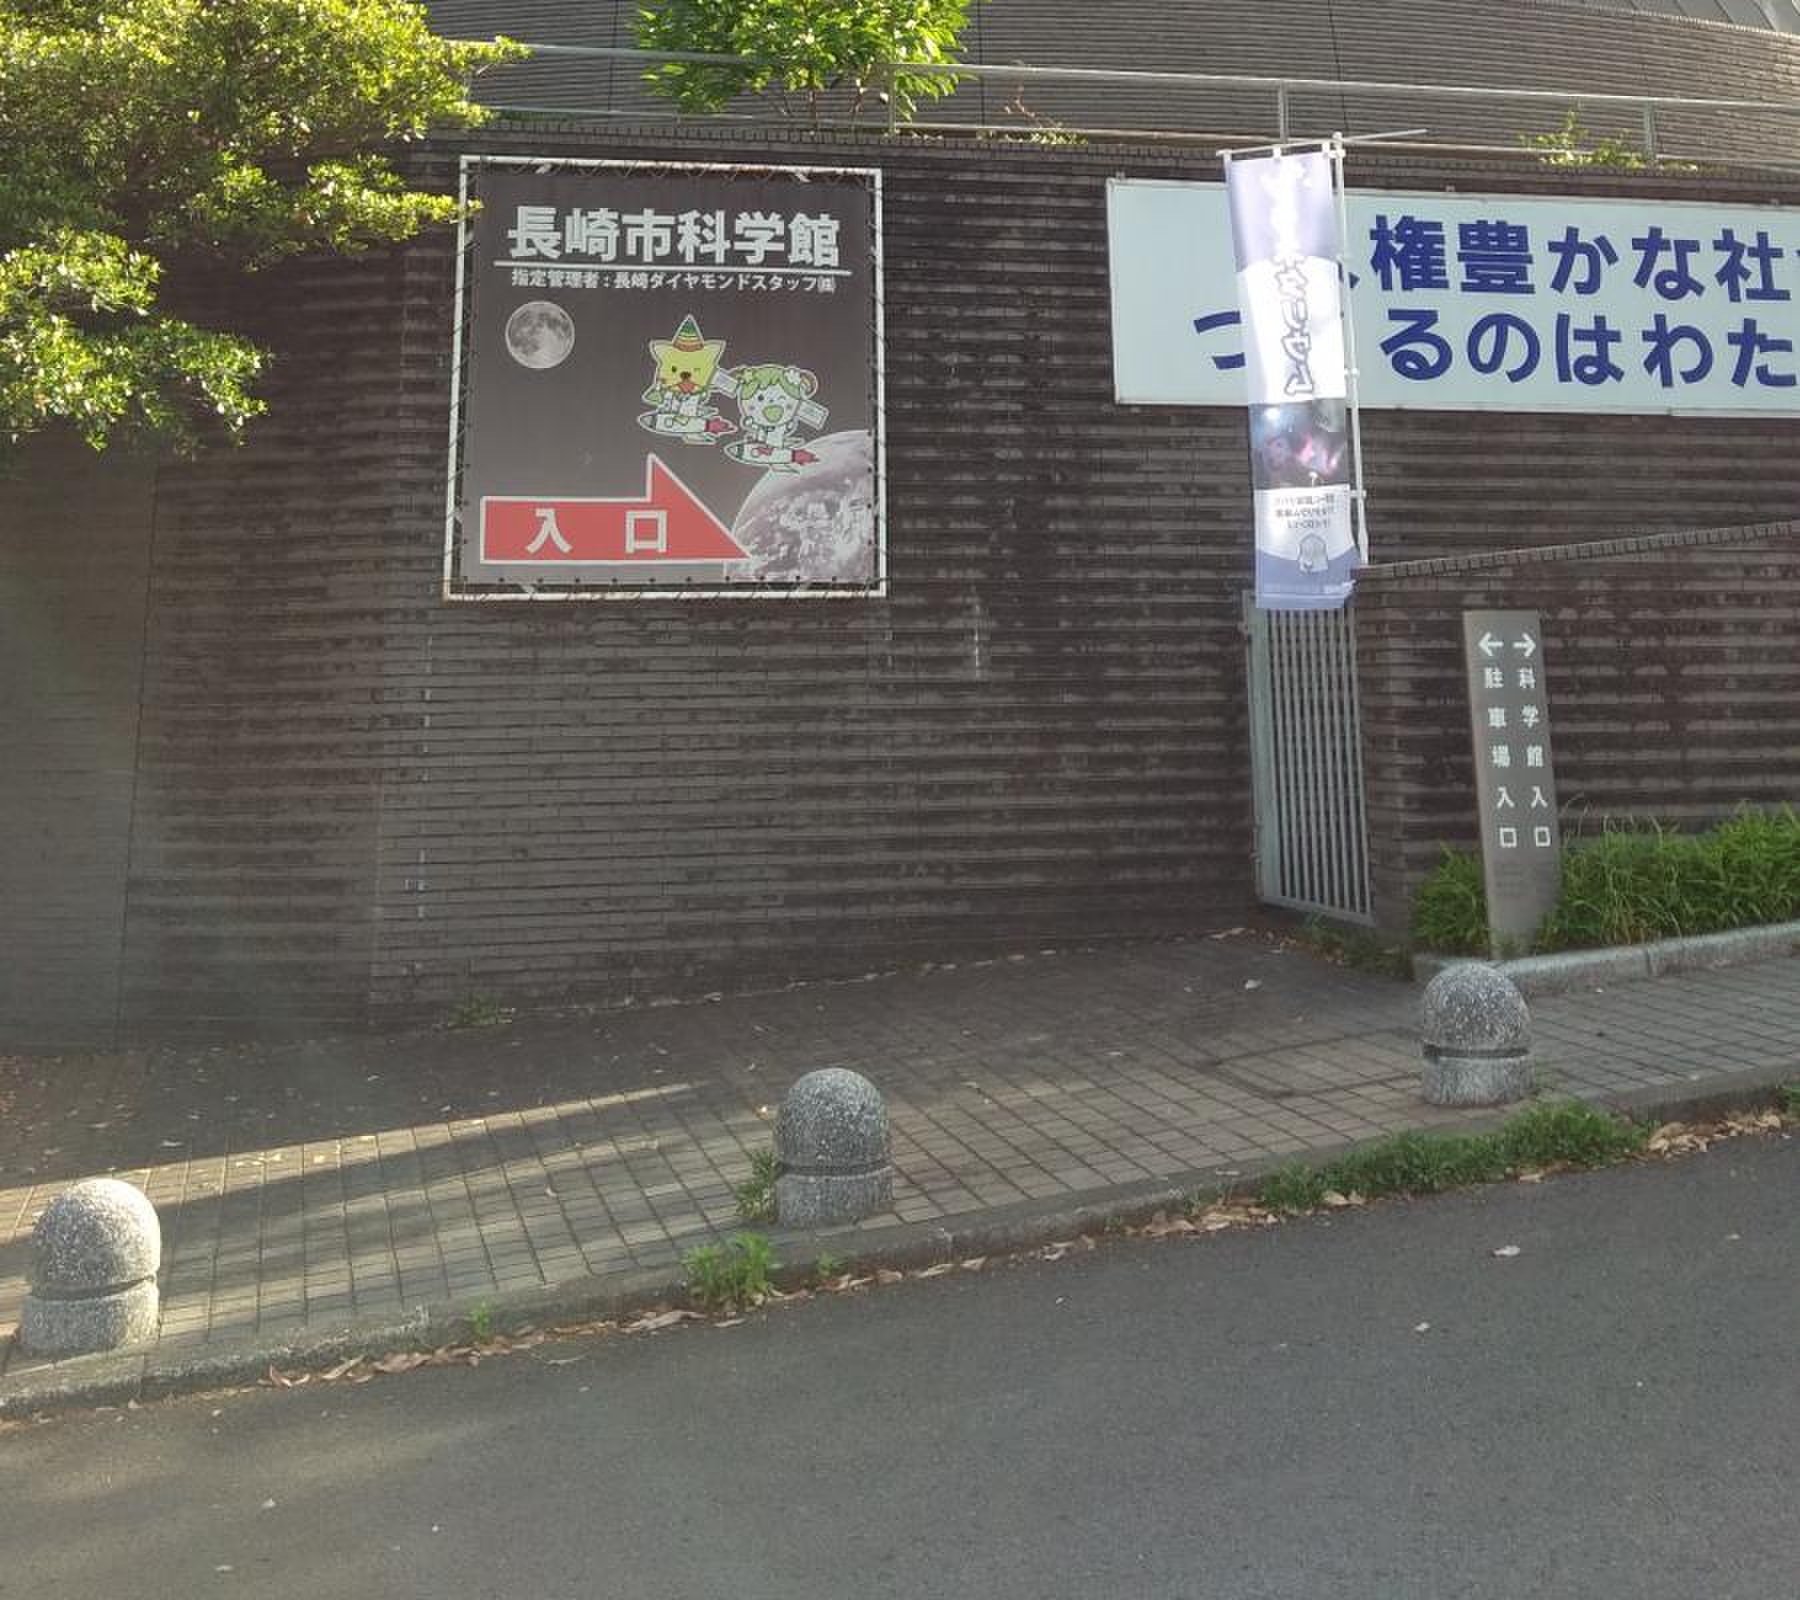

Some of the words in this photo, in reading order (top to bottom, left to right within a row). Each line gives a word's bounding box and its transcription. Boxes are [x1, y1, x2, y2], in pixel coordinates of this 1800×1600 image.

[507, 205, 842, 268] 長崎市科学館
[1337, 215, 1800, 302] 権豊かな社
[526, 507, 668, 555] 入口
[1484, 668, 1518, 847] 駐車場入口
[1518, 667, 1551, 847] 科学館入口
